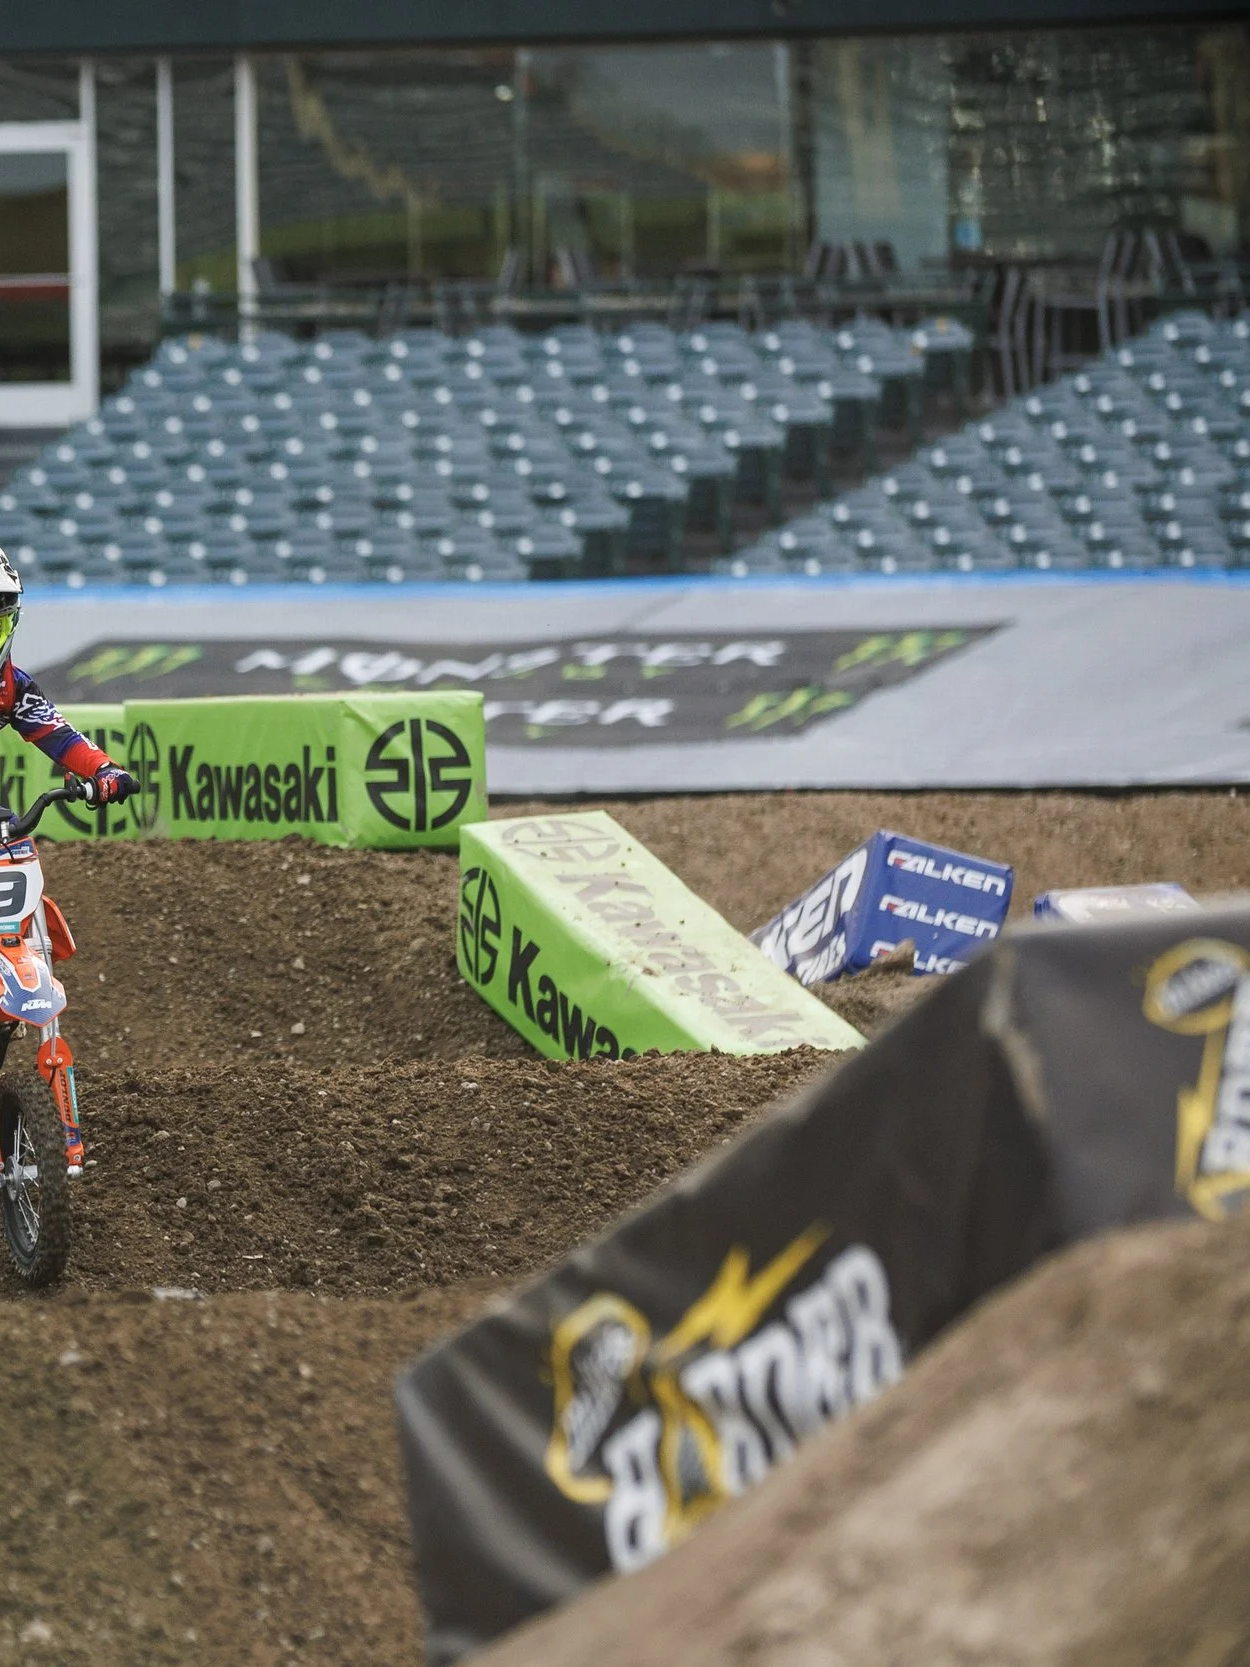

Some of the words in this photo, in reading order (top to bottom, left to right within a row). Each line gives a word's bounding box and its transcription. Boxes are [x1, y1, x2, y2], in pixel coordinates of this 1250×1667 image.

[169, 745, 339, 823] Kawasaki
[887, 848, 1007, 897] FALKEN
[878, 893, 999, 939] FALKEN
[21, 999, 52, 1012] KTM
[507, 925, 637, 1061] Kawa
[58, 1069, 71, 1122] DUNLOP
